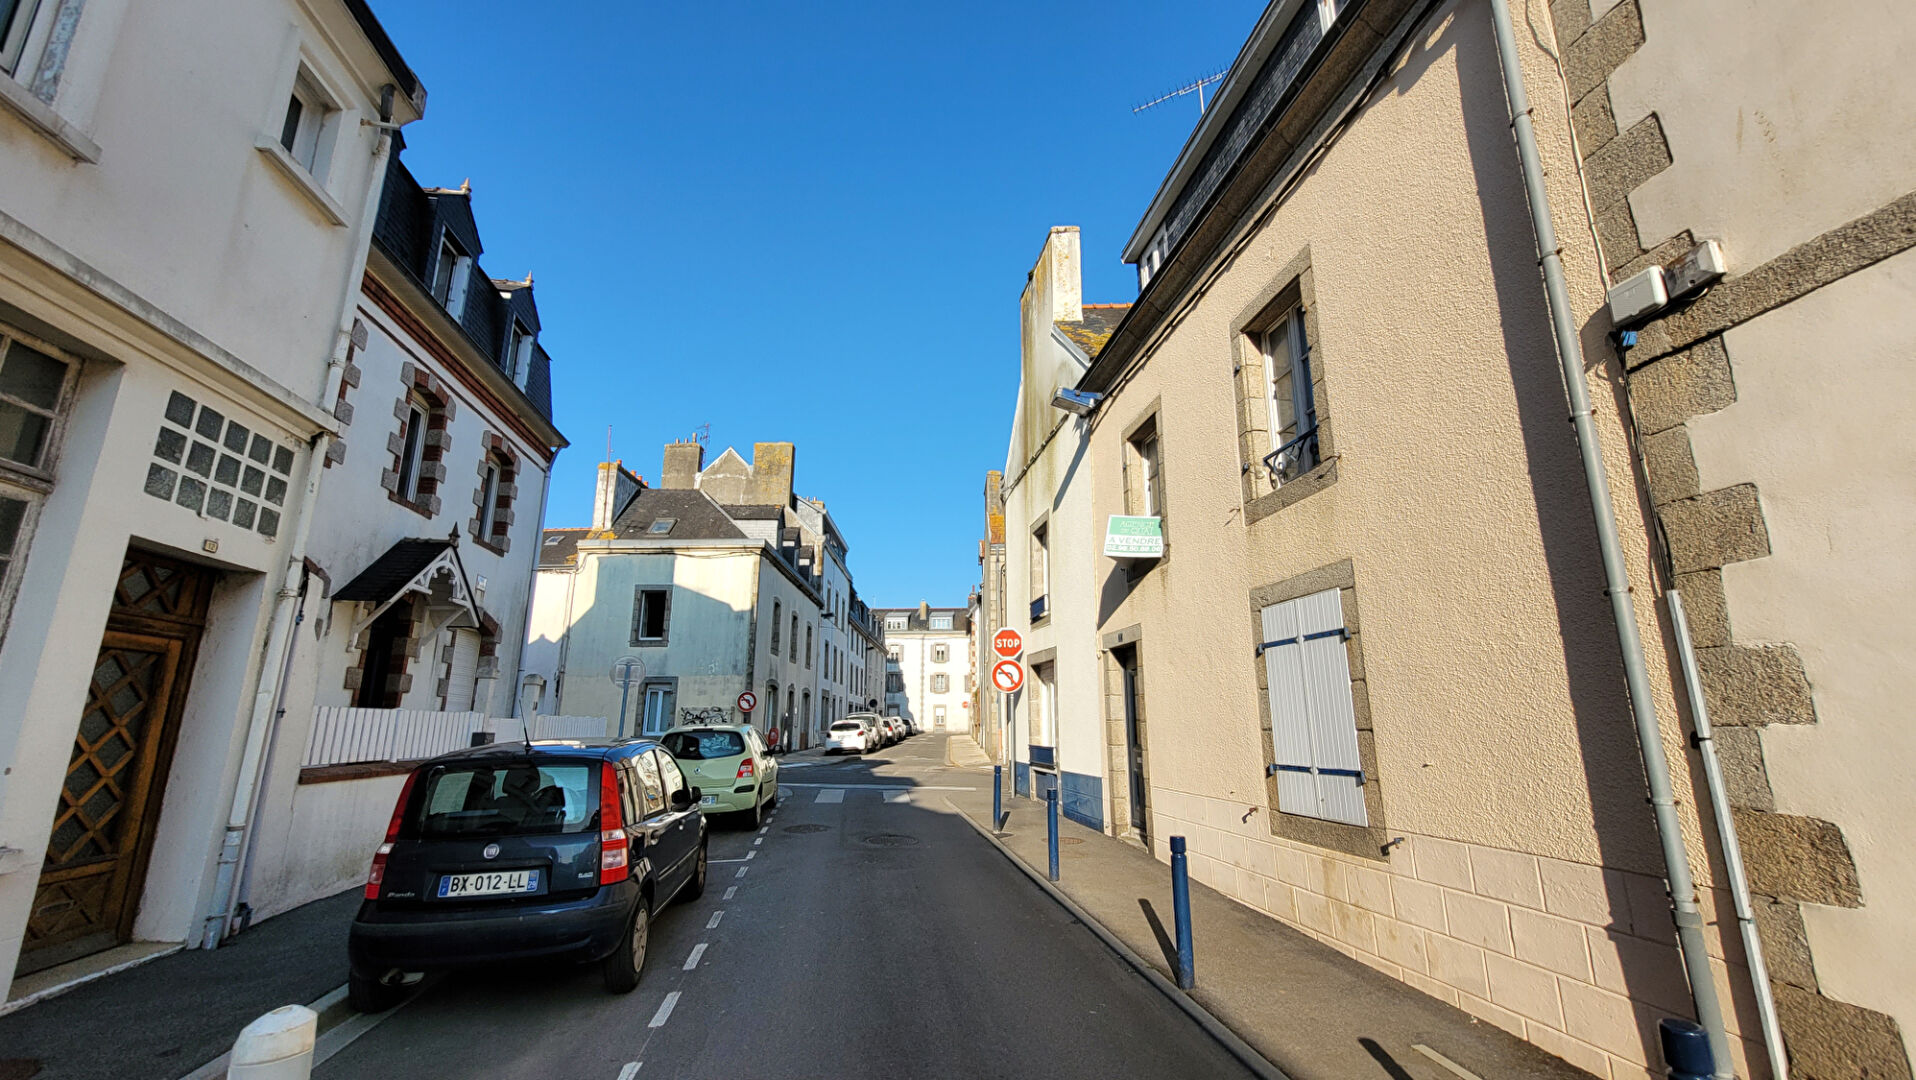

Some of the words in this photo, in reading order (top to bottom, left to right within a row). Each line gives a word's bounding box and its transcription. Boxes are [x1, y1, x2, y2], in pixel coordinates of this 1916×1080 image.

[1118, 537, 1161, 545] VENDRE
[996, 638, 1020, 648] STOP
[450, 873, 525, 892] BX-012-LL
